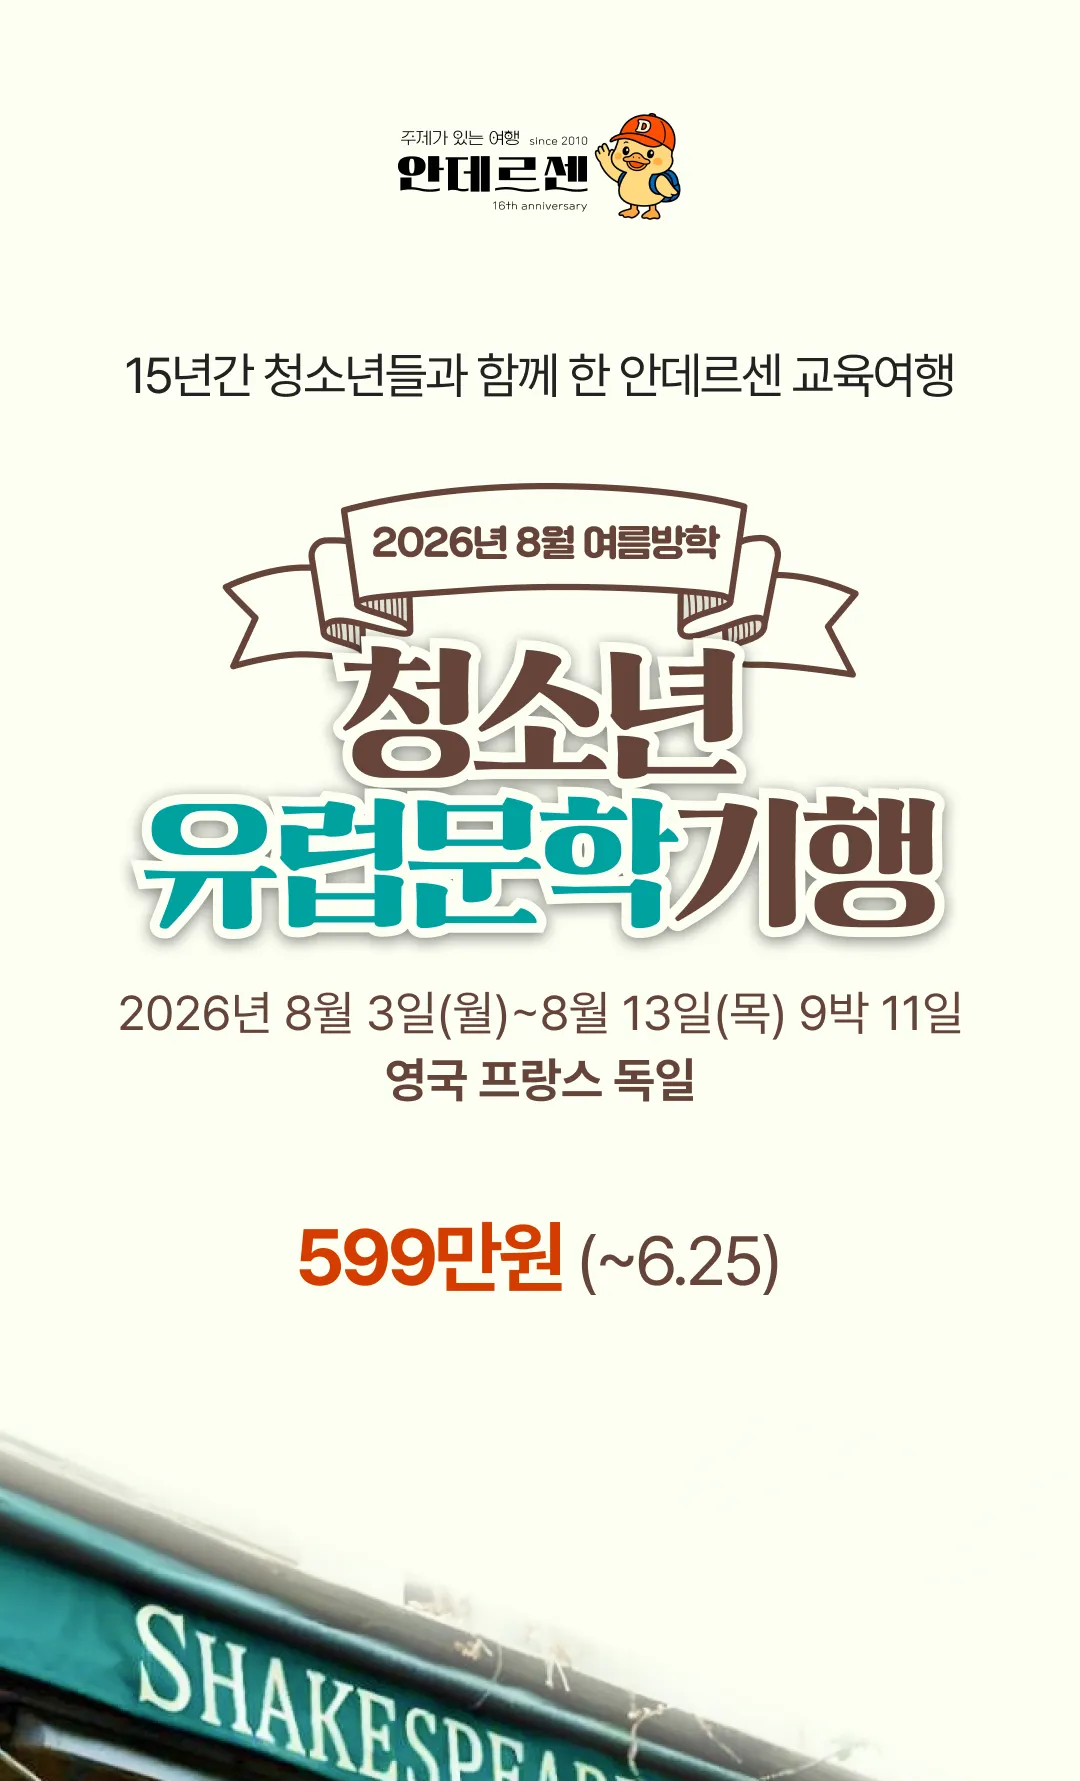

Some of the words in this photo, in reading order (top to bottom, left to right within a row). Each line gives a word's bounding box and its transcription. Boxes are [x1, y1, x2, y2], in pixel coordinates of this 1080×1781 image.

[400, 130, 448, 146] 주제가
[453, 130, 484, 146] 있는
[489, 130, 520, 146] 여행
[529, 136, 558, 146] since
[561, 136, 588, 146] 2010
[635, 119, 651, 132] D
[398, 156, 588, 192] 안데르센
[492, 201, 518, 211] 16th
[521, 202, 588, 212] anniversary
[126, 353, 254, 396] 15년간
[264, 353, 468, 397] 청소년들과
[478, 353, 556, 397] 함께
[569, 353, 610, 396] 한
[621, 353, 781, 397] 안데르센
[793, 353, 953, 397] 교육여행
[373, 525, 507, 560] 2026년
[516, 525, 575, 560] 8월
[584, 524, 721, 560] 여름방학
[343, 646, 737, 779] 청소년
[144, 797, 936, 928] 유럽문학기행
[120, 992, 269, 1033] 2026년
[286, 991, 351, 1034] 8월
[369, 991, 607, 1040] 3일(월)~8월
[624, 991, 783, 1040] 13일(목)
[801, 991, 869, 1034] 9박
[883, 991, 961, 1034] 11일
[386, 1058, 467, 1102] 영국
[479, 1058, 602, 1102] 프랑스
[614, 1058, 693, 1102] 독일
[299, 1221, 562, 1291] 599만원
[581, 1234, 778, 1295] (~6.25)
